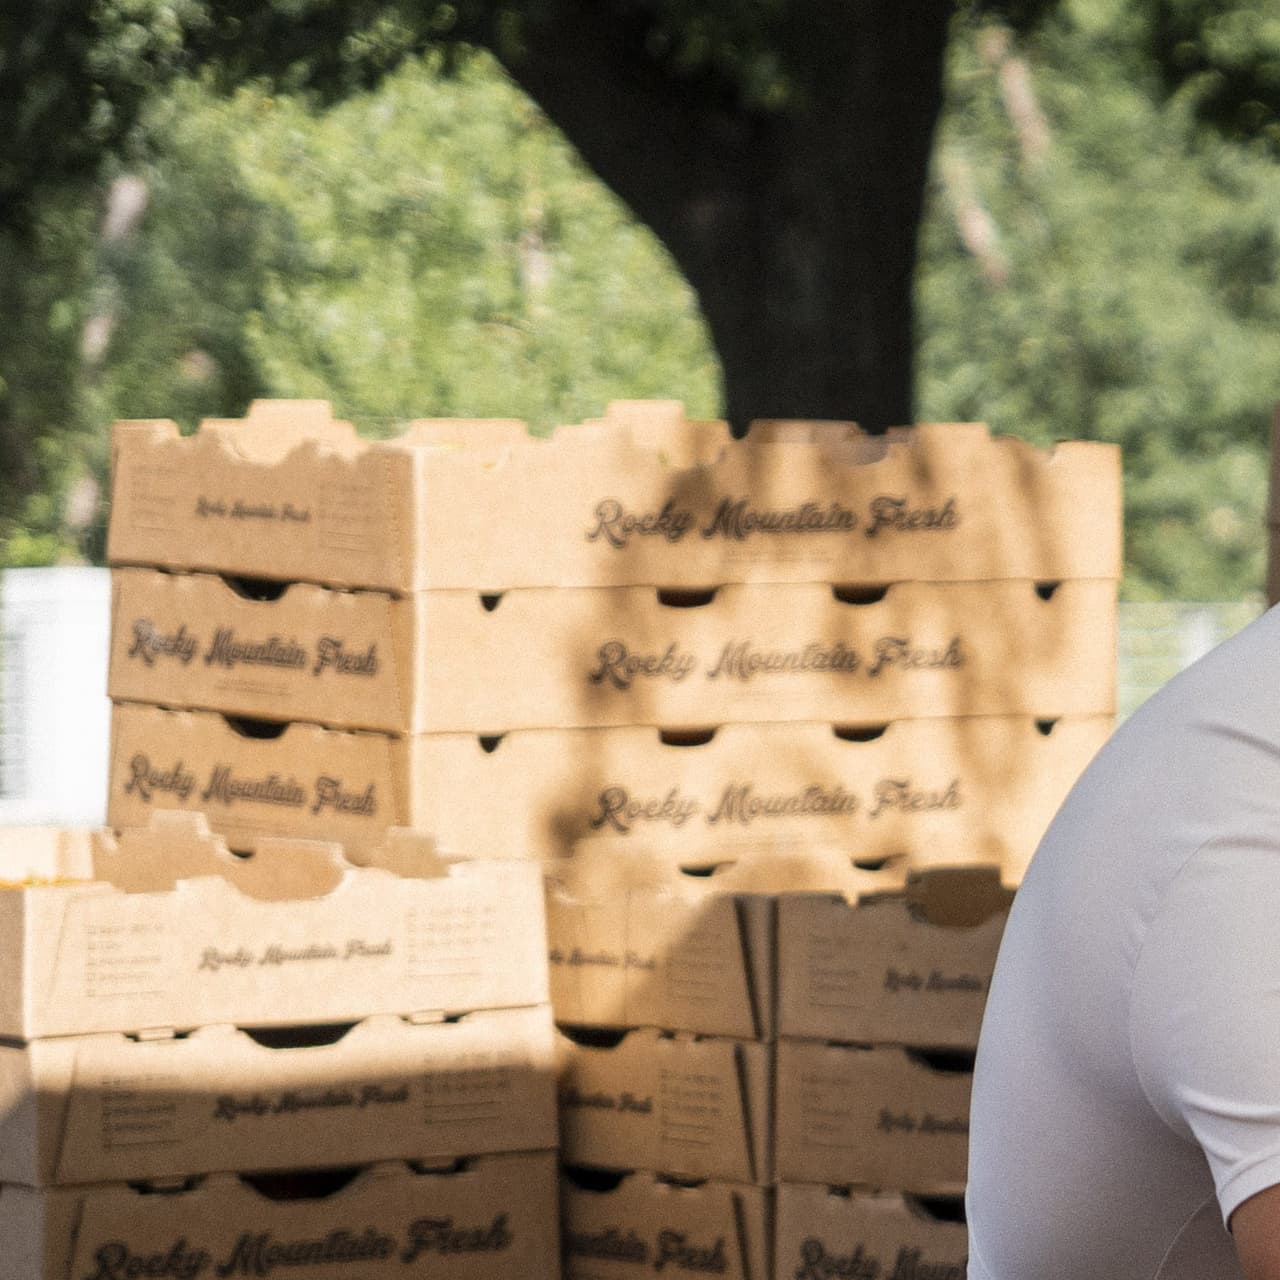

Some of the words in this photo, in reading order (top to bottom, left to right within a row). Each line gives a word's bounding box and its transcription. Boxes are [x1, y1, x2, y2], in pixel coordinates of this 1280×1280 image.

[586, 498, 696, 548] Rocky
[701, 496, 858, 540] Mountain
[865, 495, 960, 538] Fresh
[589, 639, 696, 689] Rocky
[707, 638, 859, 680] Mountain
[868, 636, 965, 678] Fresh
[591, 780, 698, 834] Rocky
[704, 783, 859, 825] Mountain
[869, 778, 962, 820] Fresh
[215, 1227, 398, 1277] Mountain
[400, 1213, 511, 1263] Fresh
